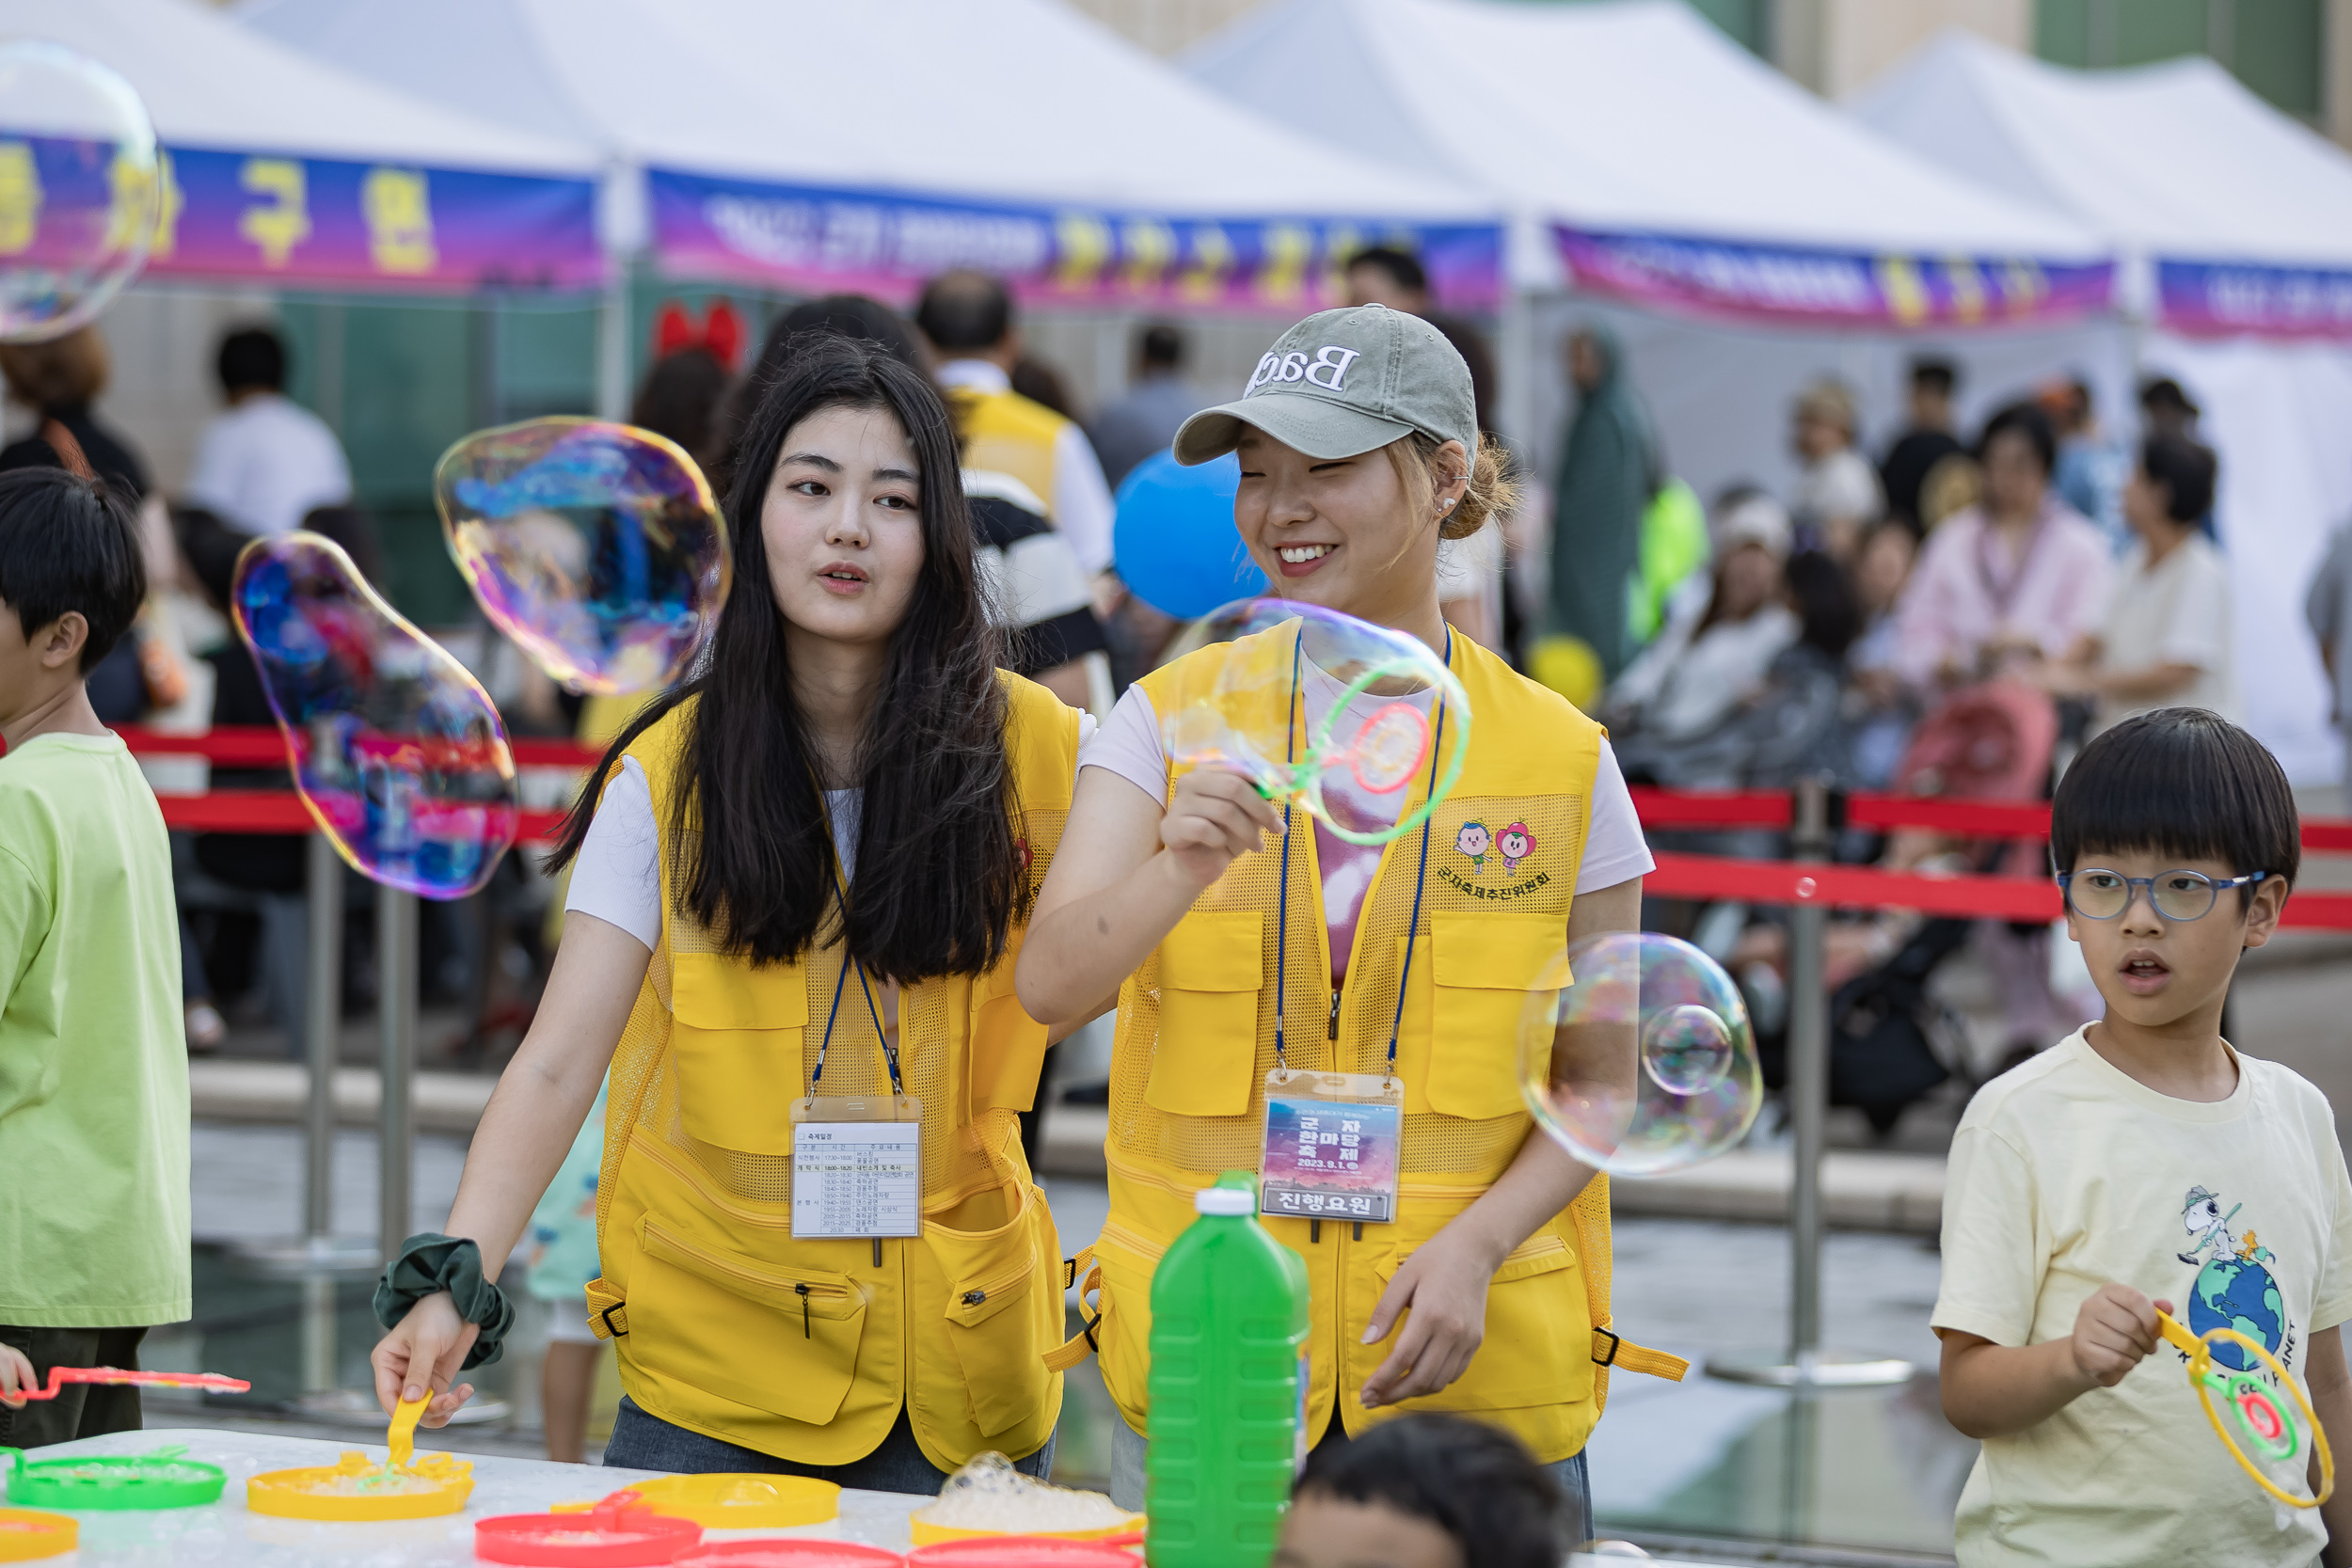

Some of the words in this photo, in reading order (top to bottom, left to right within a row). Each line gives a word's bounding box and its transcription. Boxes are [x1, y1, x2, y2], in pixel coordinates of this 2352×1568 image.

[1438, 866, 1550, 901] 군자축제추진위원회
[1298, 1131, 1361, 1147] 한마당
[1278, 1192, 1370, 1215] 진행요원
